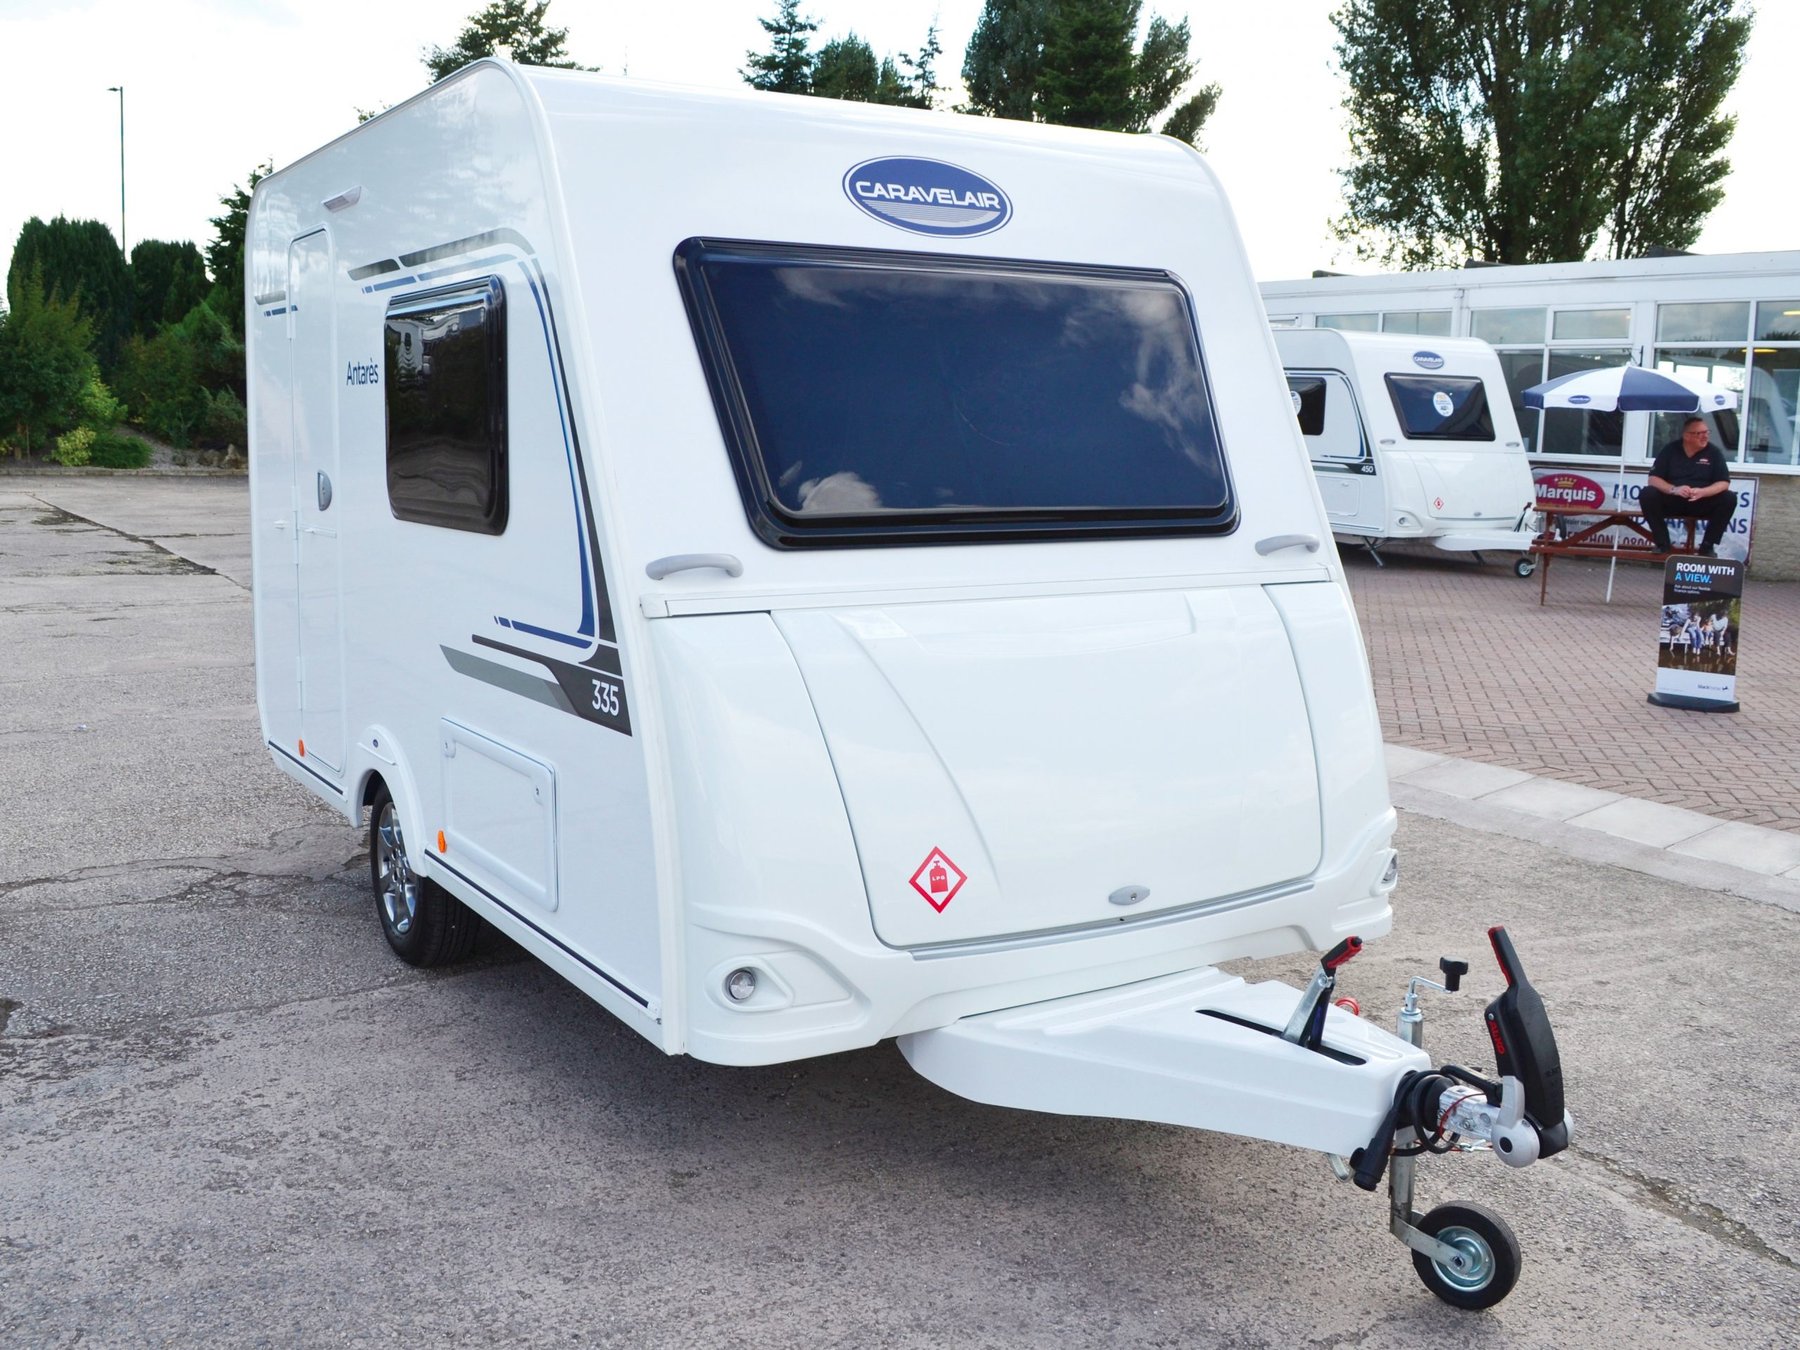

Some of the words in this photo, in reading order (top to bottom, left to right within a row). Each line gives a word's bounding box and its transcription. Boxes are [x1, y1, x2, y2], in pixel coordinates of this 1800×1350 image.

[855, 181, 1001, 209] CARAVELAIR
[346, 357, 379, 386] Antarès
[1361, 466, 1374, 474] 450
[1535, 484, 1597, 502] Marquis
[1675, 572, 1683, 582] A
[1684, 573, 1712, 584] VIEW.
[1676, 562, 1706, 574] ROOM
[1708, 564, 1735, 576] WITH
[592, 679, 620, 717] 335
